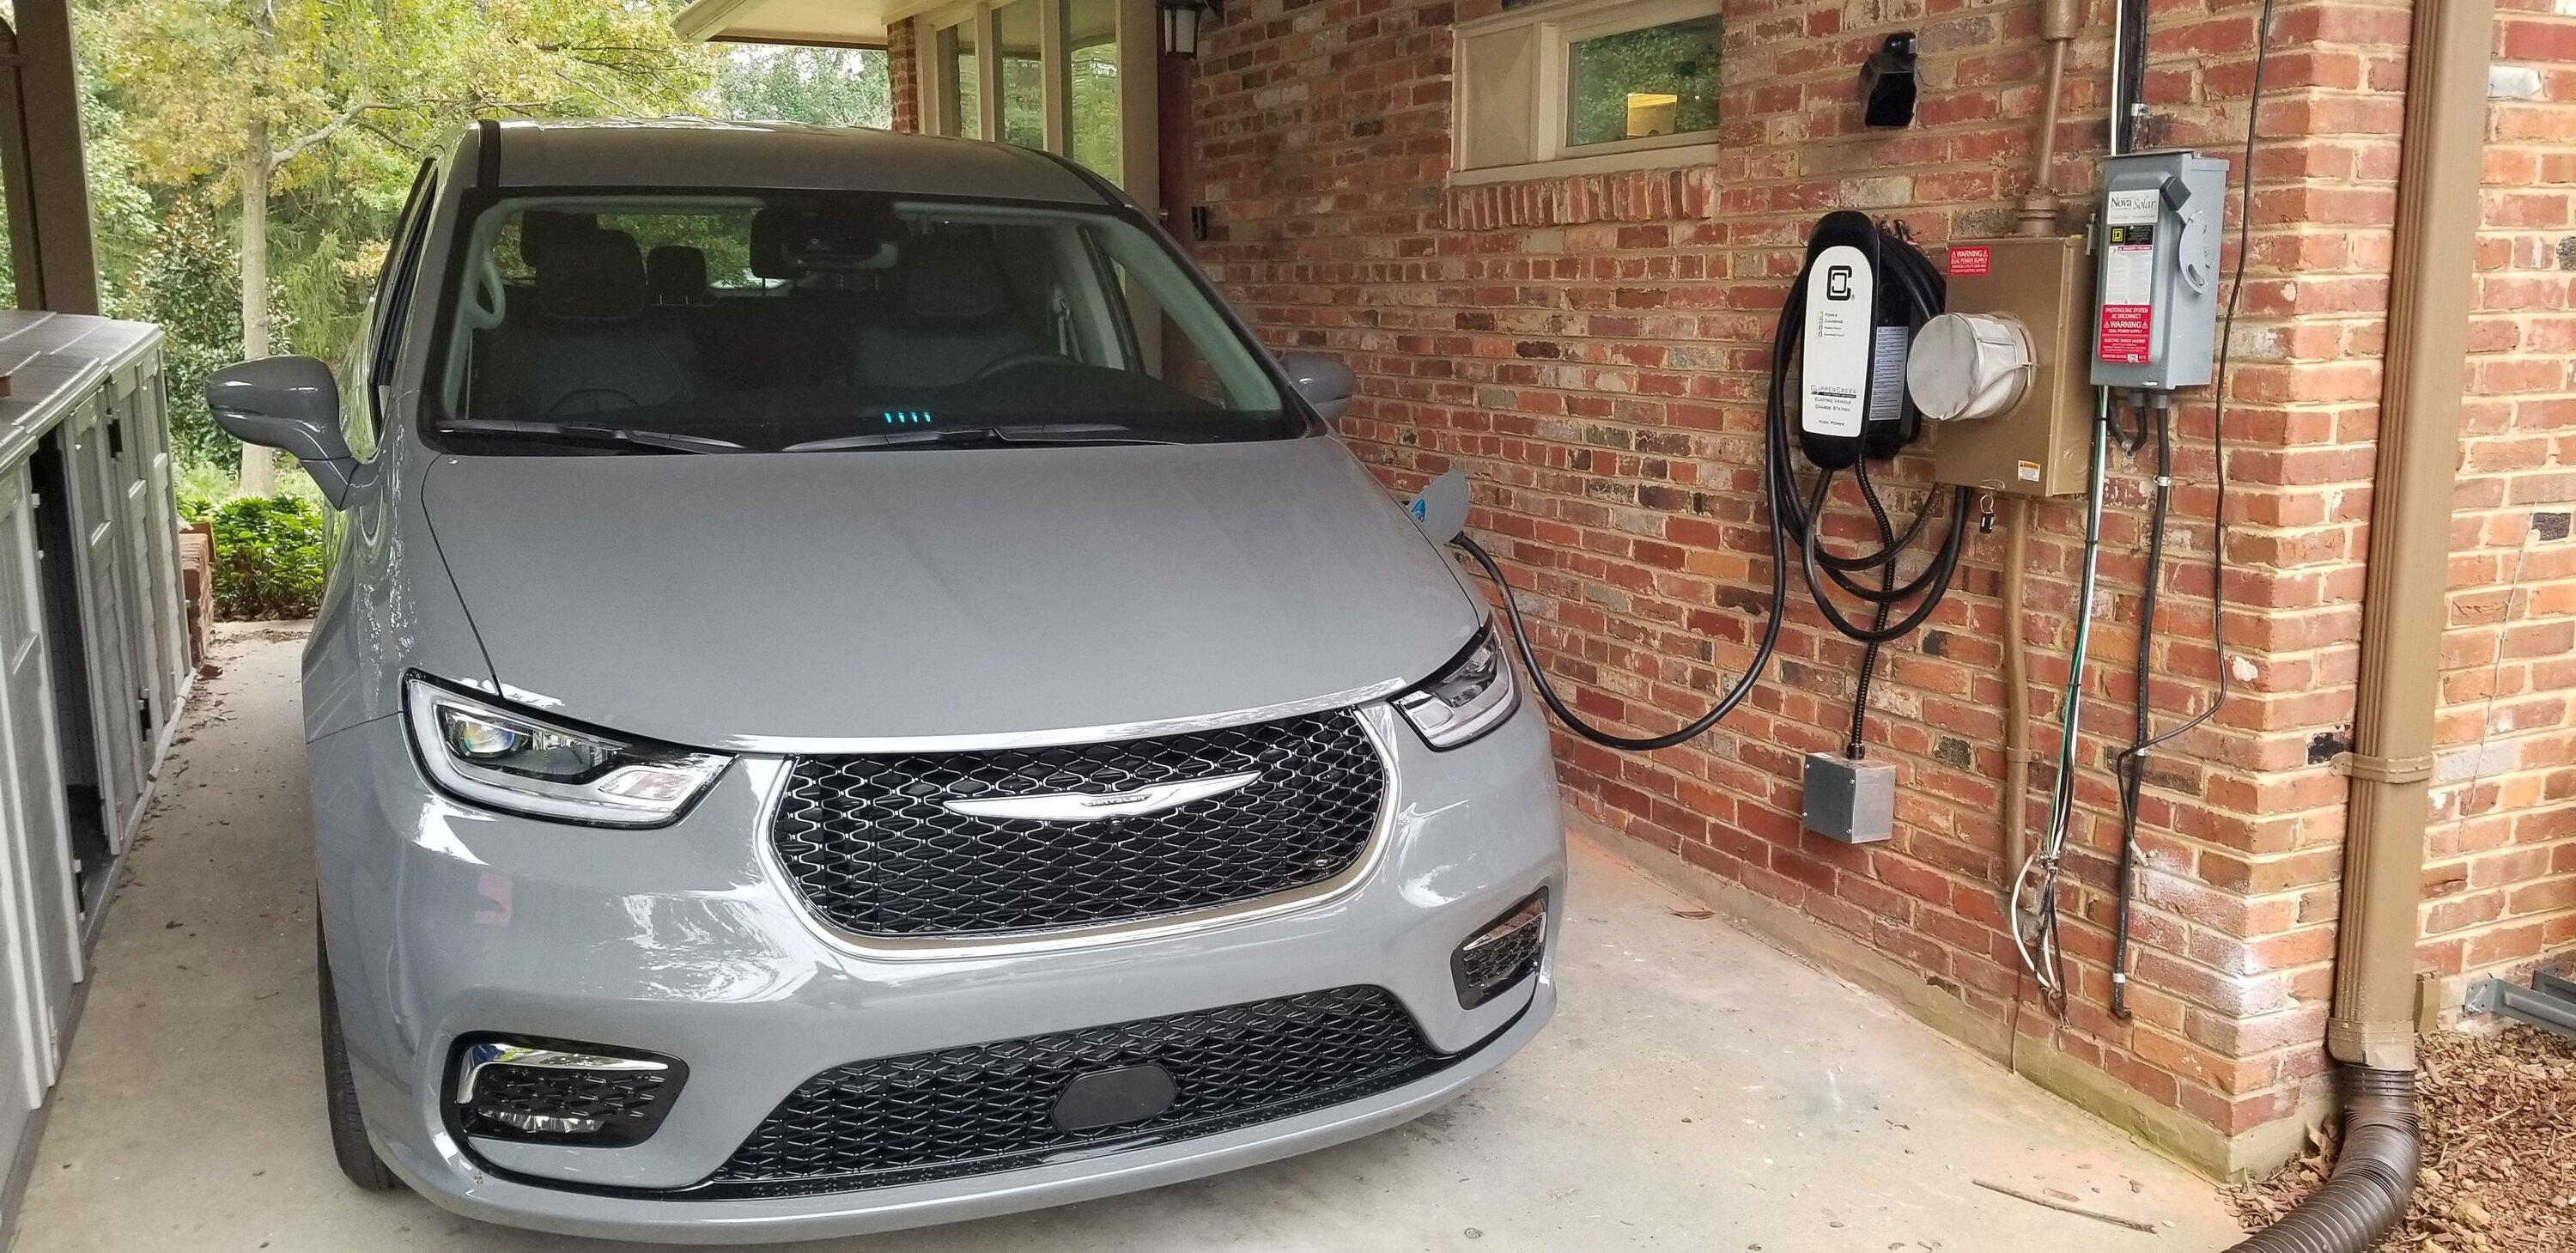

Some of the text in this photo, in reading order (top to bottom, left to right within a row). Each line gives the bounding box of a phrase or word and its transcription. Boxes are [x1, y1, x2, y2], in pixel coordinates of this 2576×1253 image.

[2111, 195, 2156, 210] Nova Solar
[1085, 795, 1145, 806] CHRYSLER
